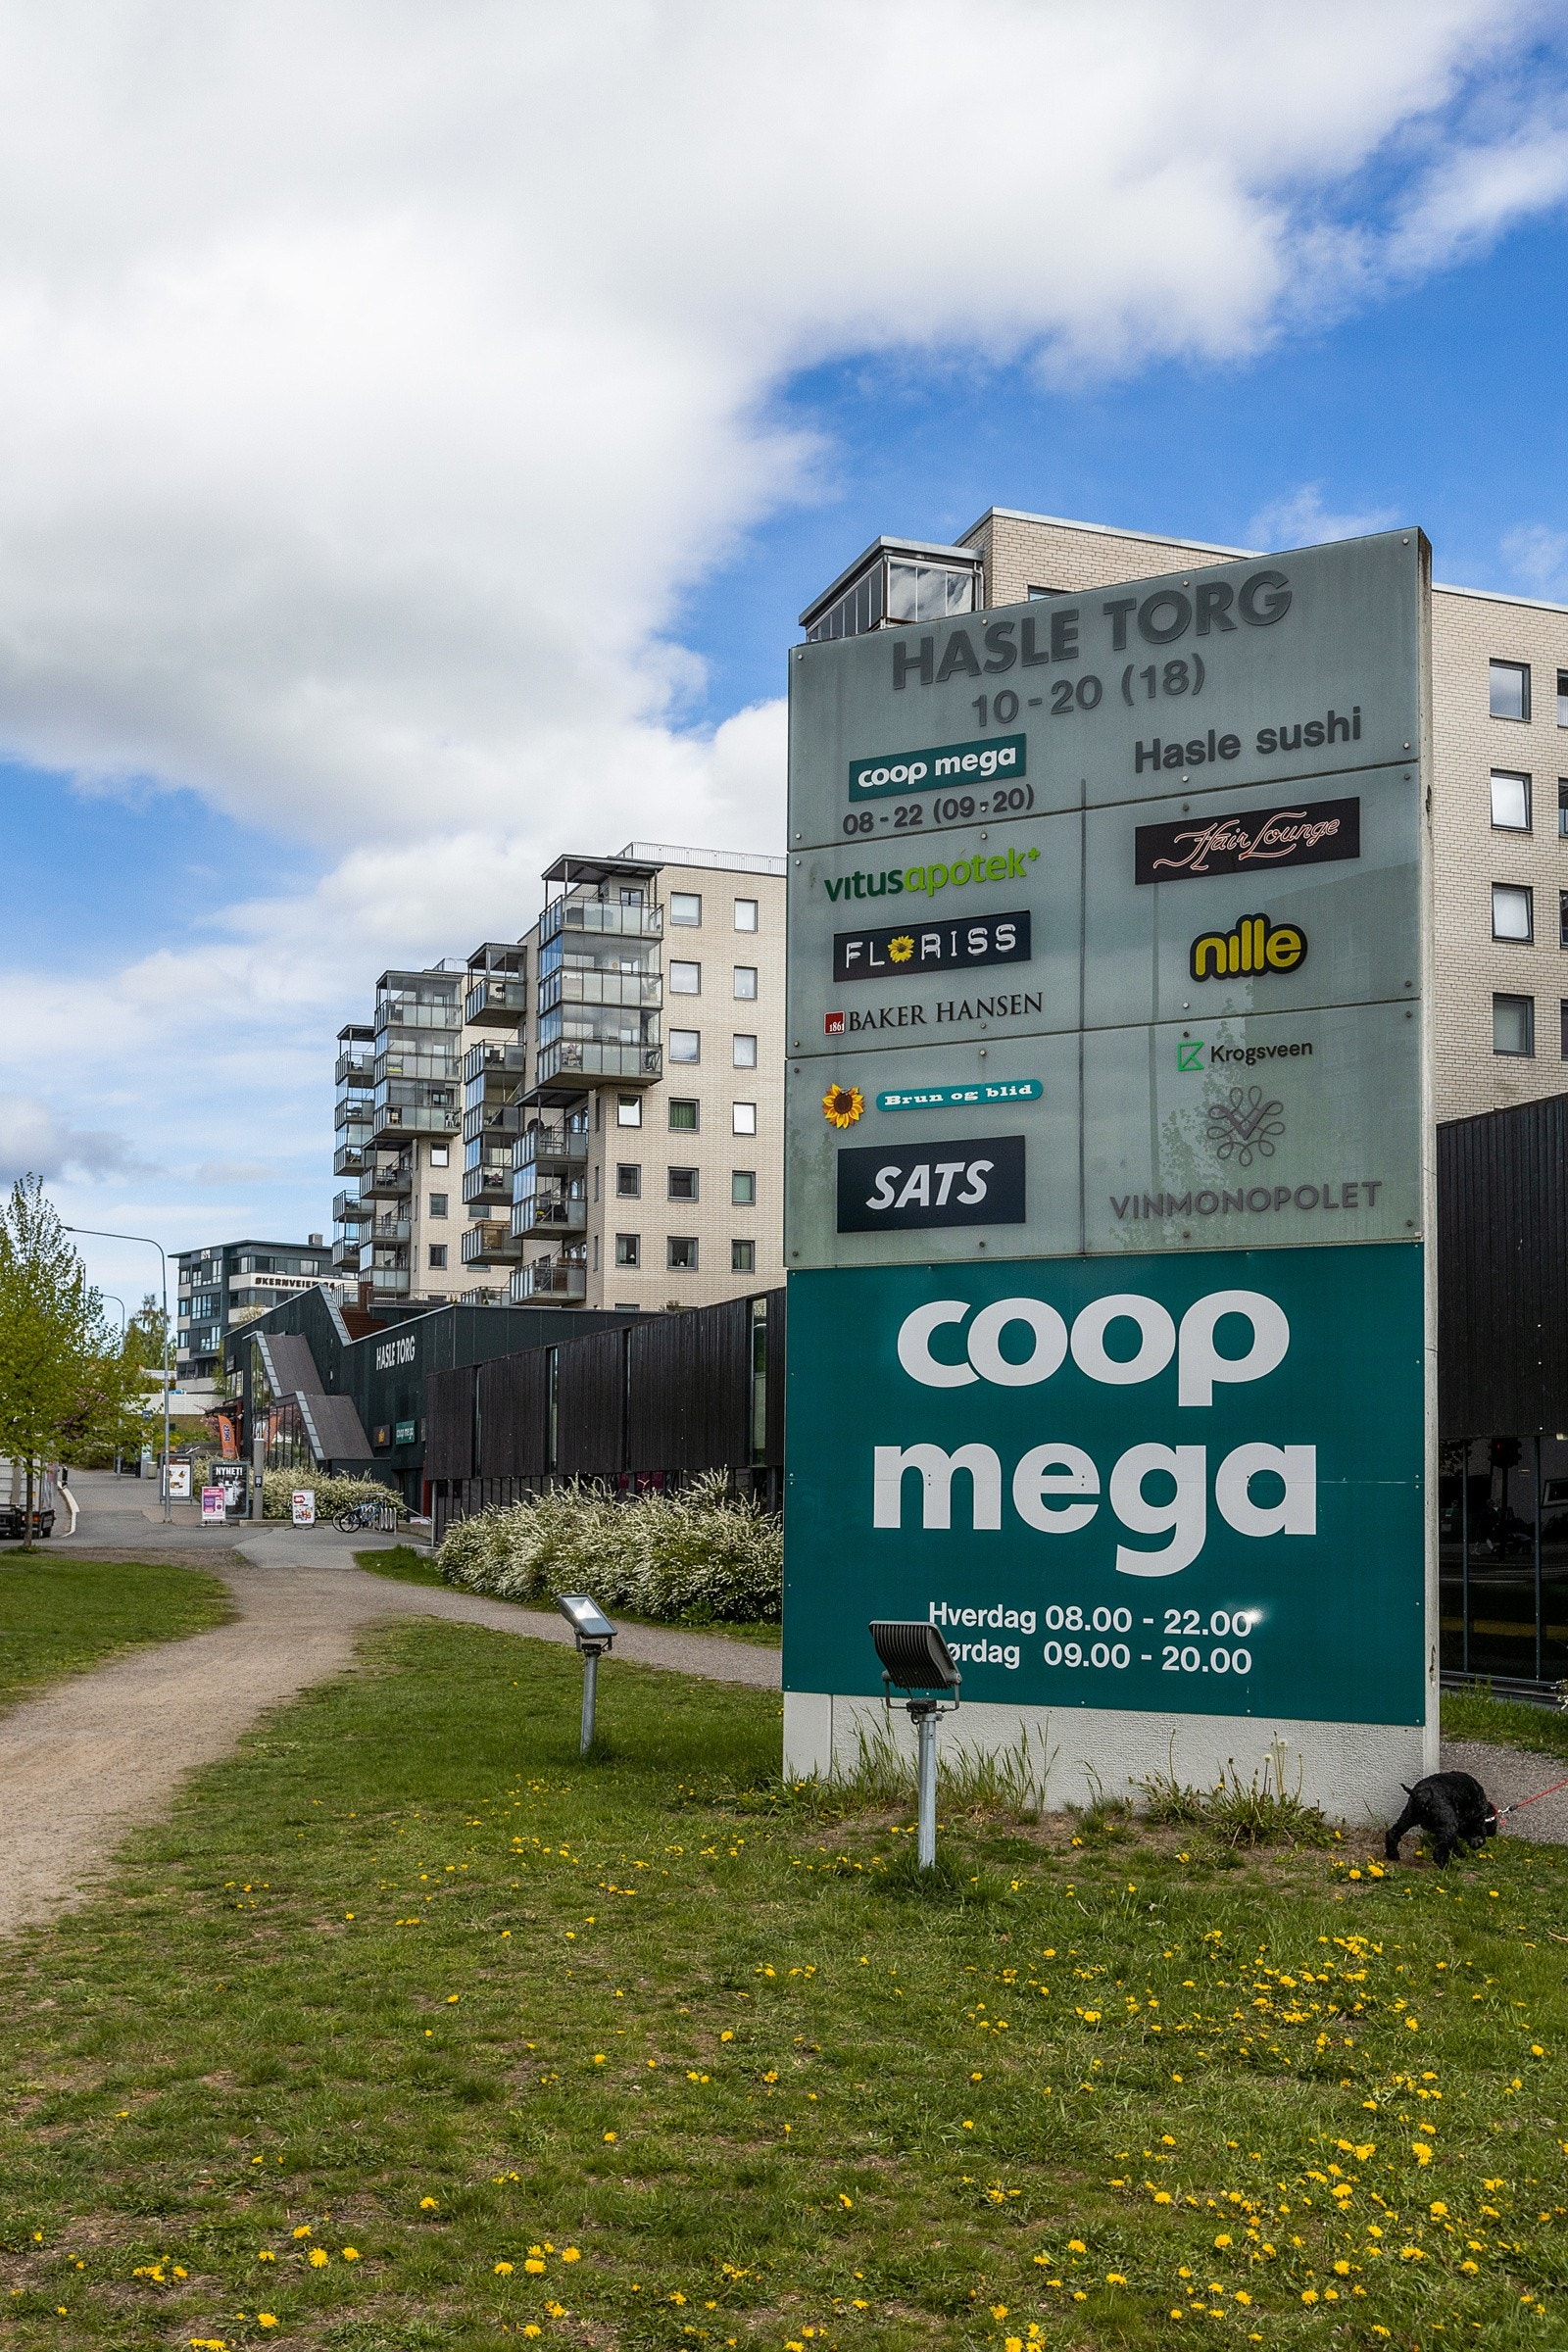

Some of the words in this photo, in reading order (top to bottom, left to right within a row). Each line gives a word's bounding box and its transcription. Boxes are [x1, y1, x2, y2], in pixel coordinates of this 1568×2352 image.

[892, 609, 1080, 690] HASLE
[1102, 569, 1294, 652] TORG
[1121, 653, 1205, 707] (18)
[1134, 732, 1242, 774] Hasle
[1255, 708, 1362, 753] sushi
[858, 760, 928, 788] coop
[934, 748, 1017, 776] mega
[1152, 819, 1250, 870] Hair
[1239, 811, 1342, 859] Lounge
[1195, 918, 1305, 977] nille
[848, 1004, 926, 1032] BAKER
[936, 991, 1044, 1020] HANSEN
[1210, 1039, 1313, 1066] Krogsveen
[884, 1093, 943, 1106] Brun
[951, 1089, 979, 1103] og
[986, 1082, 1033, 1098] blid
[865, 1158, 995, 1209] SATS
[1109, 1180, 1384, 1220] VINMONOPOLET
[375, 1341, 395, 1371] HASLE
[396, 1335, 416, 1365] TORG
[897, 1289, 1291, 1407] coop
[216, 1467, 243, 1476] NYHET!
[873, 1442, 1317, 1577] mega
[929, 1602, 1037, 1635] Hverdag
[1045, 1605, 1133, 1633] 08.00
[1163, 1609, 1252, 1638] 22.00
[947, 1640, 1020, 1668] ørdag
[1044, 1641, 1131, 1669] 09.00
[1161, 1645, 1252, 1674] 20.00
